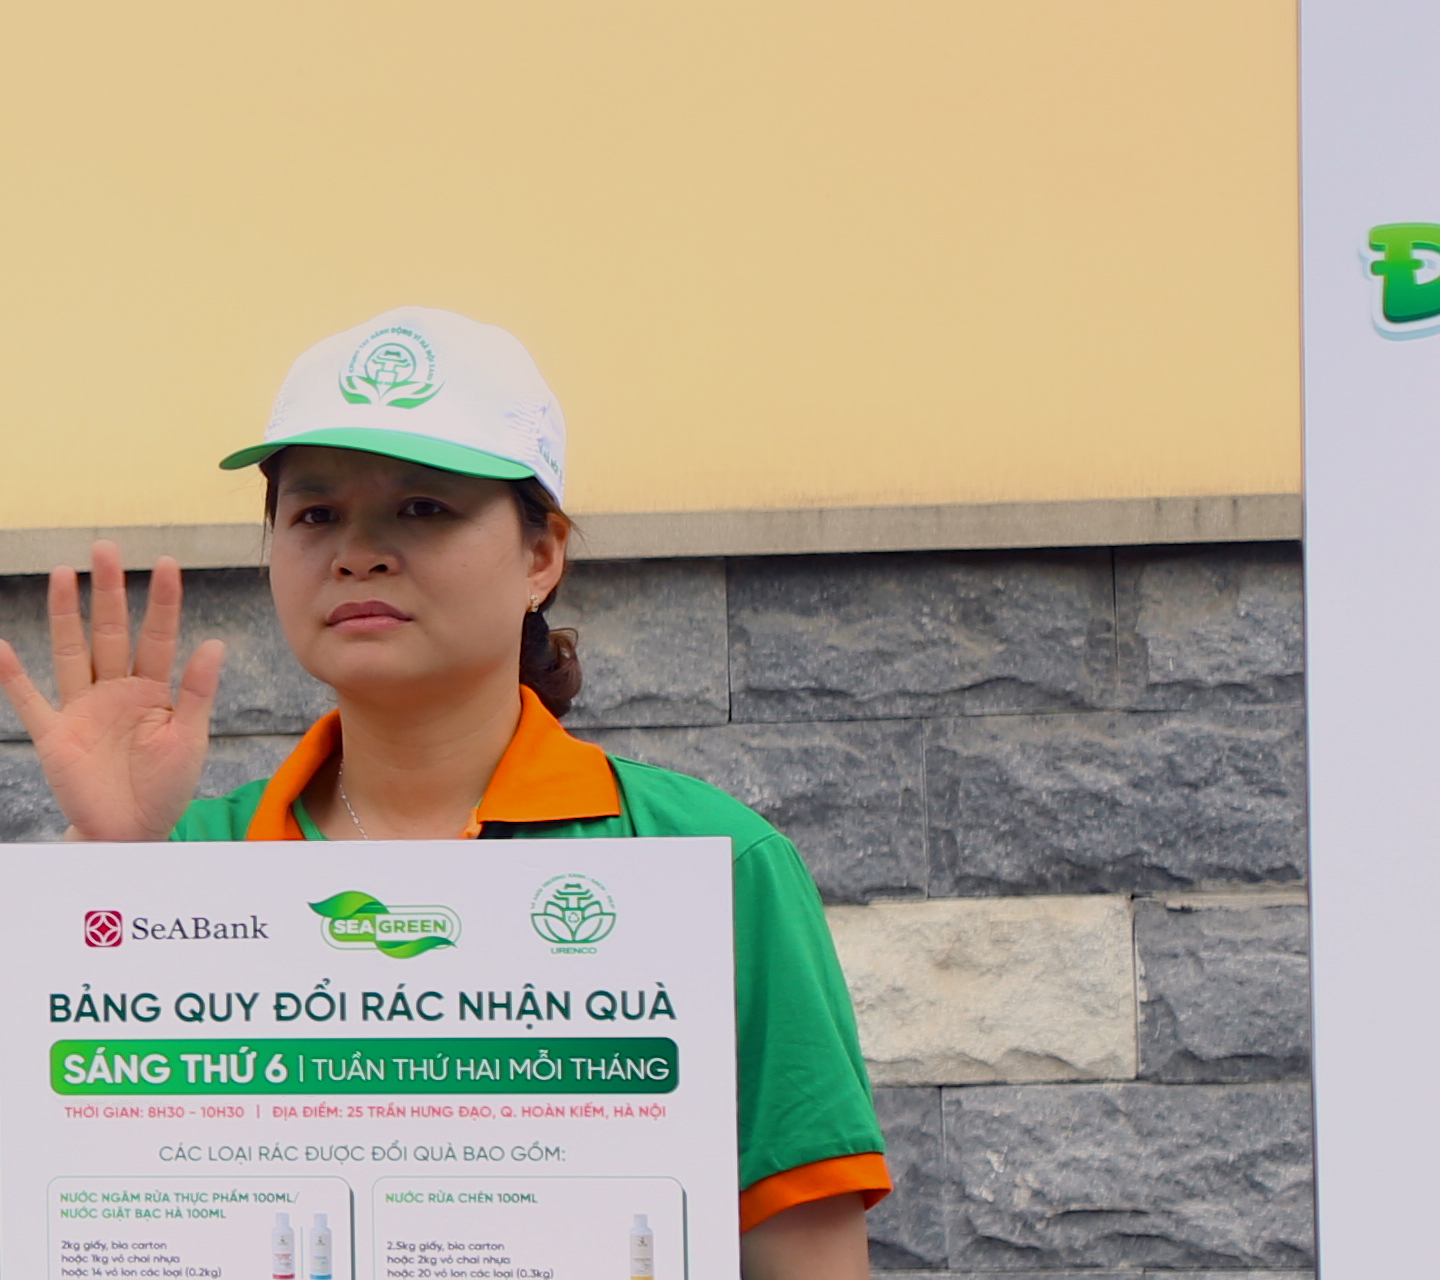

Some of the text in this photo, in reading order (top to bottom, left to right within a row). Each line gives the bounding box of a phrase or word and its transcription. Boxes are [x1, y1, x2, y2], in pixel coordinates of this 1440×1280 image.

[132, 915, 268, 939] SeABank
[333, 919, 447, 934] SEA GREEN
[50, 978, 676, 1029] BẢNG QUY ĐỔI RÁC NHẬN QUÀ
[63, 1046, 671, 1084] SÁNG THỨ 6 TUẦN THỨ HAI MỖI THÁNG
[64, 1102, 665, 1120] THỜI GIAN: 8H30 10H30 ĐỊA ĐIỂM: 25 TRẦN HƯNG ĐẠO, Q. HOÀN KIẾM, HÀ NỘI
[159, 1140, 565, 1164] CÁC LOẠI RÁC ĐƯỢC ĐỔI QUÀ BAO GỒM:
